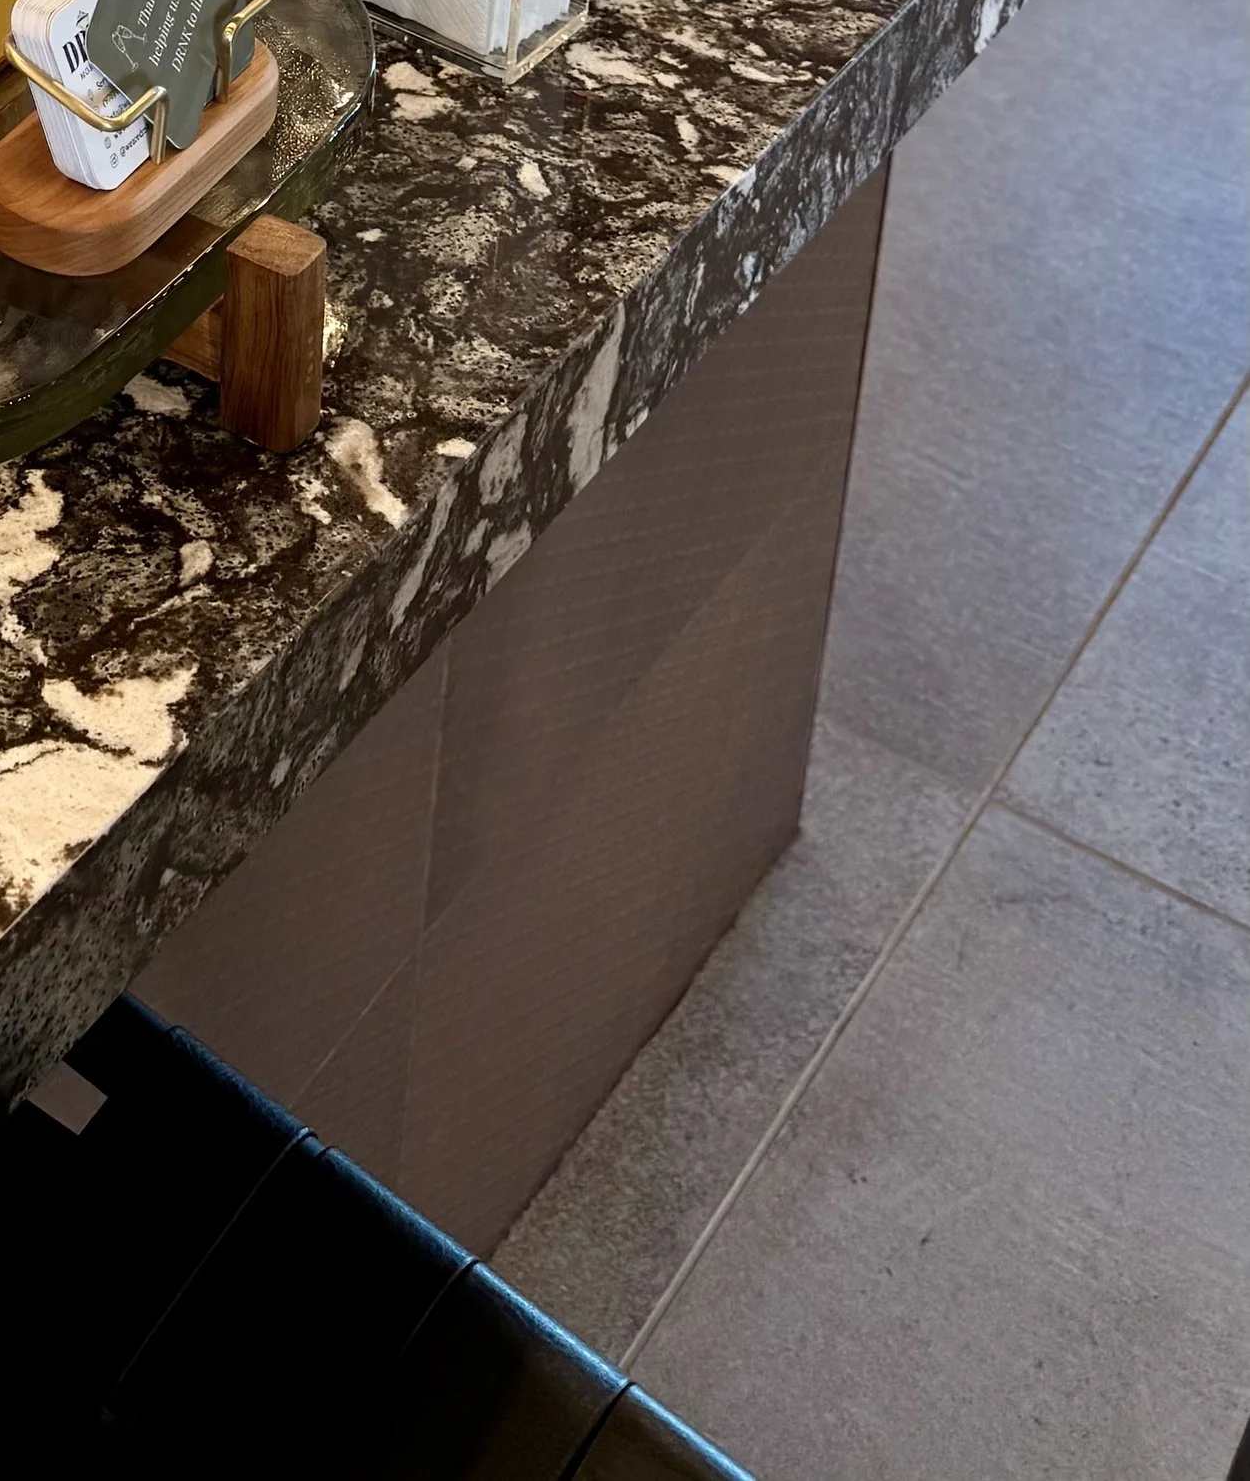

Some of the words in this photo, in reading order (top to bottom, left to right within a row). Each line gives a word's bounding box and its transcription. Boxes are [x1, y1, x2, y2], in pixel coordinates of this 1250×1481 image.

[149, 6, 177, 68] helping
[171, 27, 194, 73] DRNK
[188, 8, 199, 27] to
